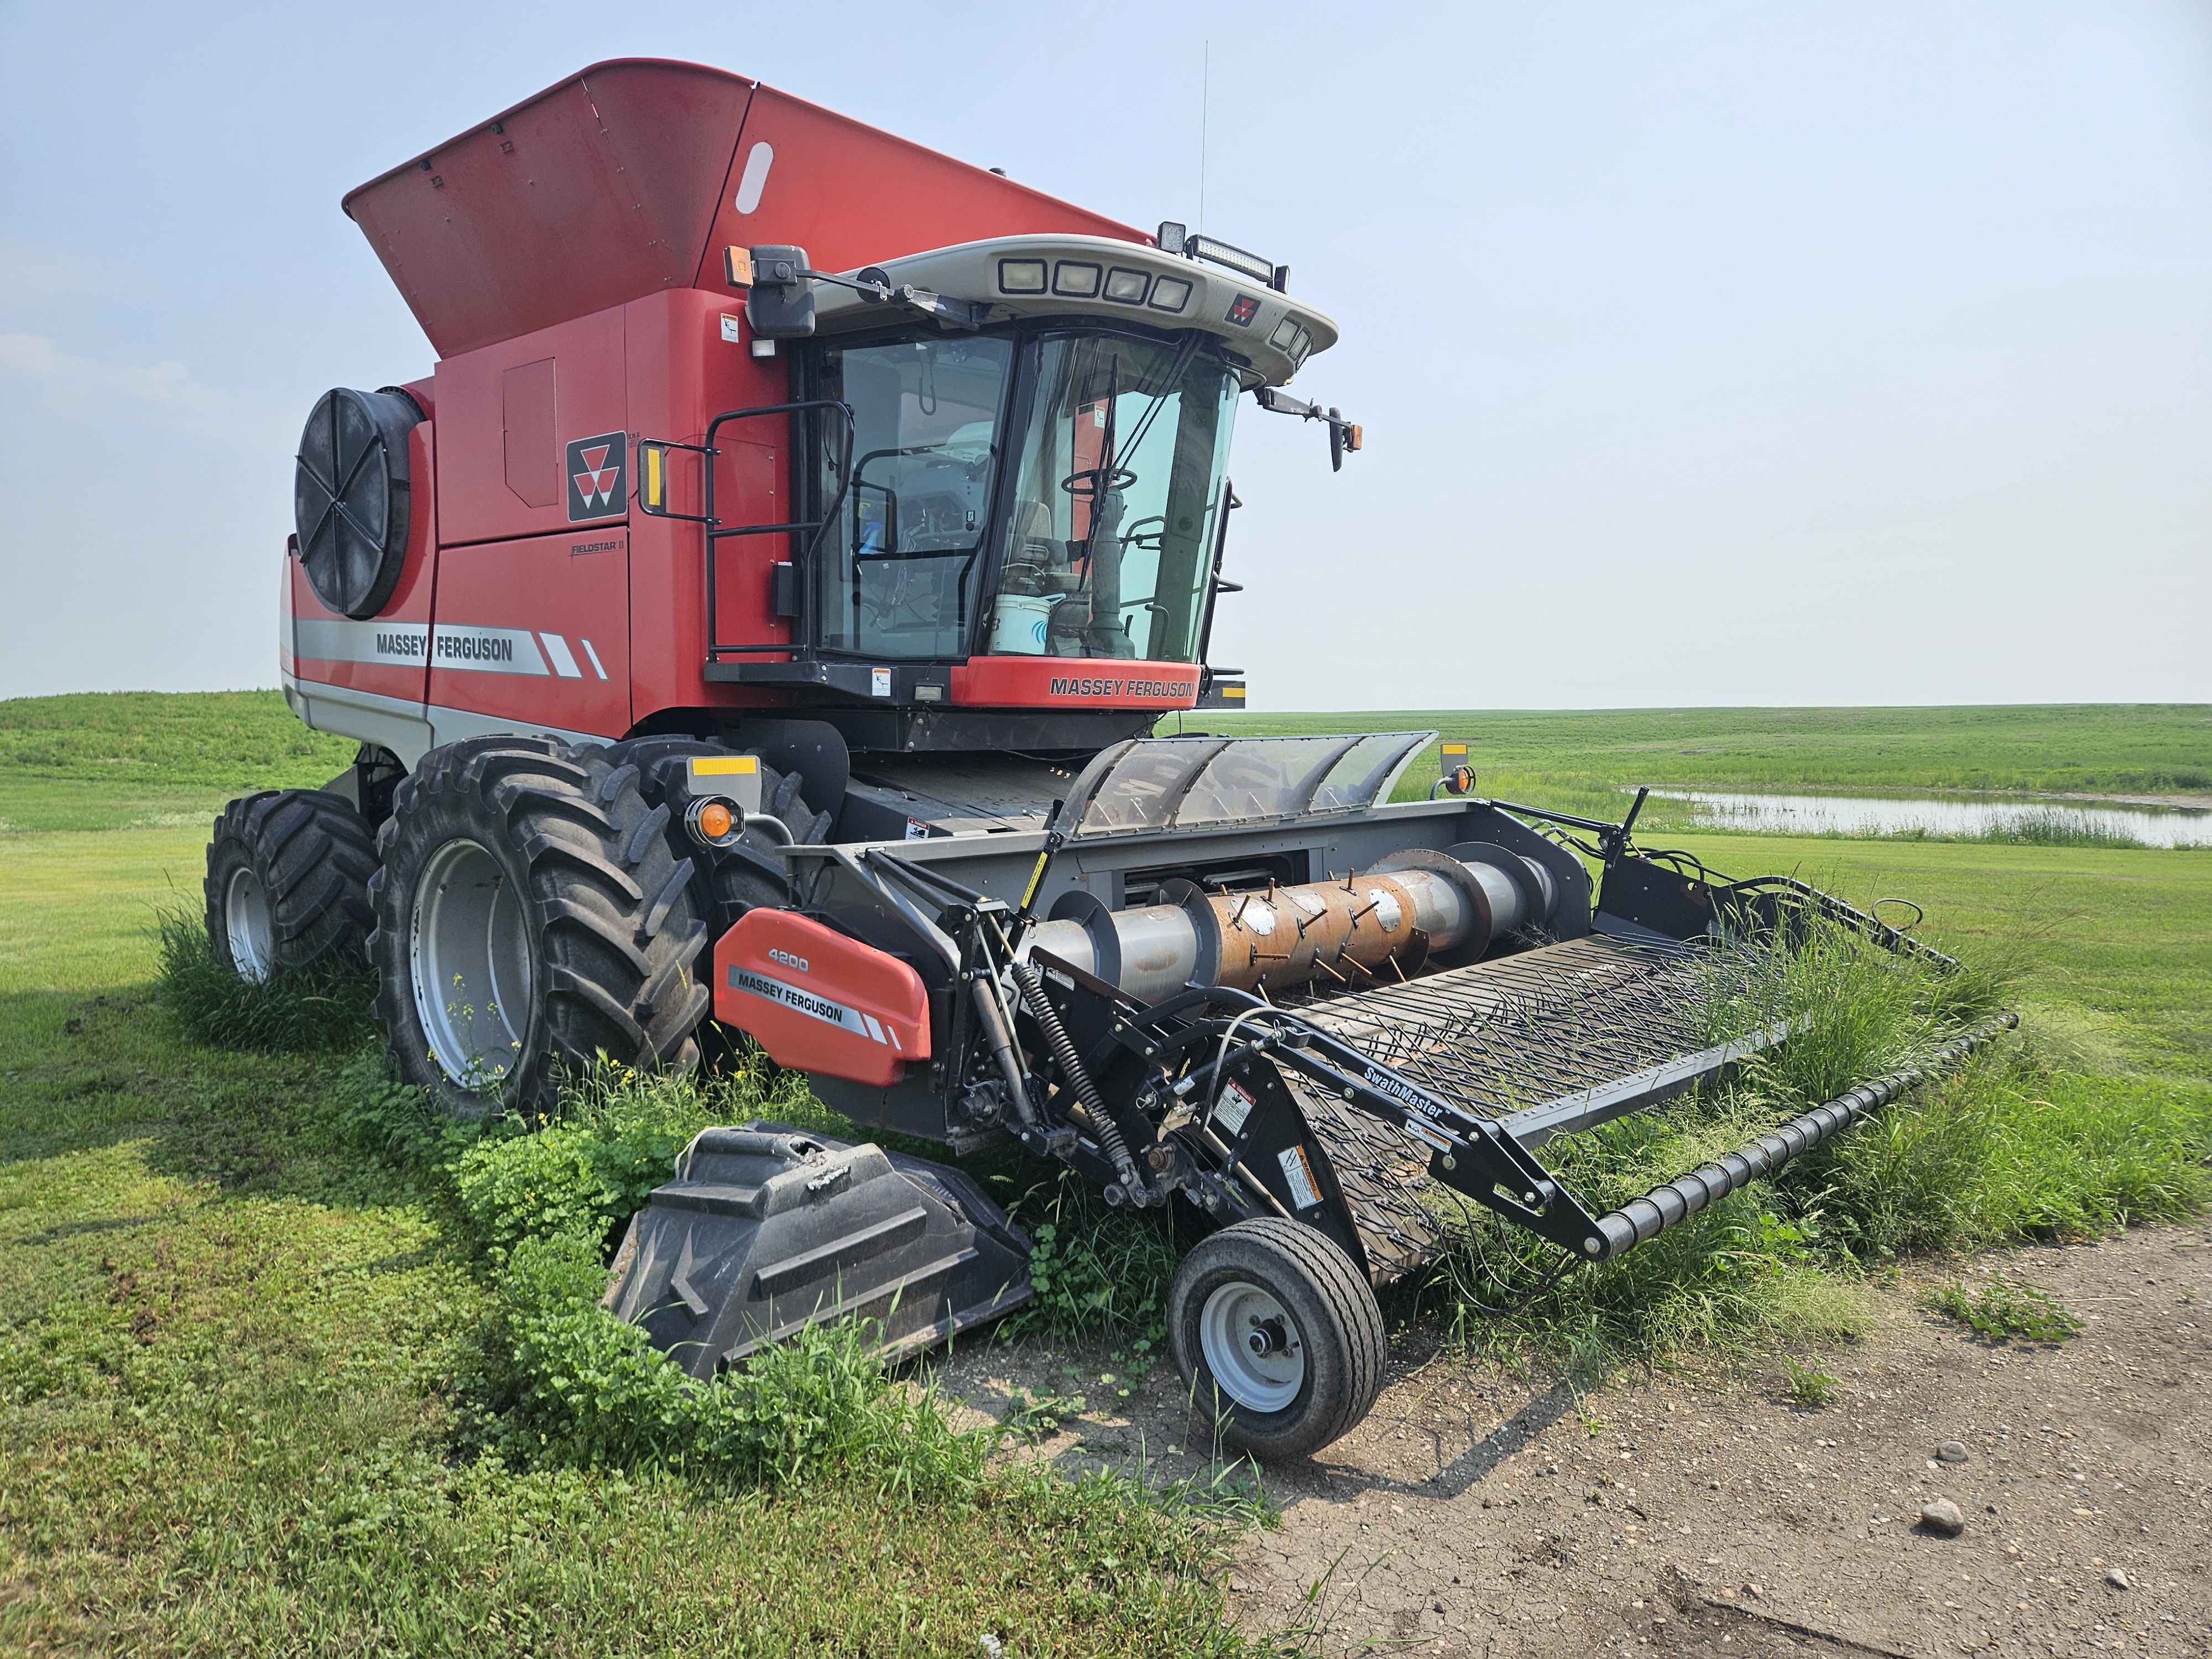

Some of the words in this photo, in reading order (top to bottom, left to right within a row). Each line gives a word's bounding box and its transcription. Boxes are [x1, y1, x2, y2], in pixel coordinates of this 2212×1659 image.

[572, 542, 616, 554] FIELDSTAR
[619, 541, 624, 549] II
[377, 633, 426, 656] MASSEY
[437, 635, 512, 662] FERGUSON
[1050, 678, 1124, 696] MASSEY
[1126, 680, 1195, 697] FERGUSON
[768, 948, 809, 973] 4200
[738, 974, 783, 999] MASSEY
[785, 990, 842, 1022] FERGUSON
[1236, 1087, 1251, 1102] DANGER
[1364, 1067, 1443, 1118] SwathMaster
[1234, 1109, 1245, 1119] HAZARD
[1428, 1131, 1448, 1144] WARNING
[1303, 1162, 1317, 1191] WARNING
